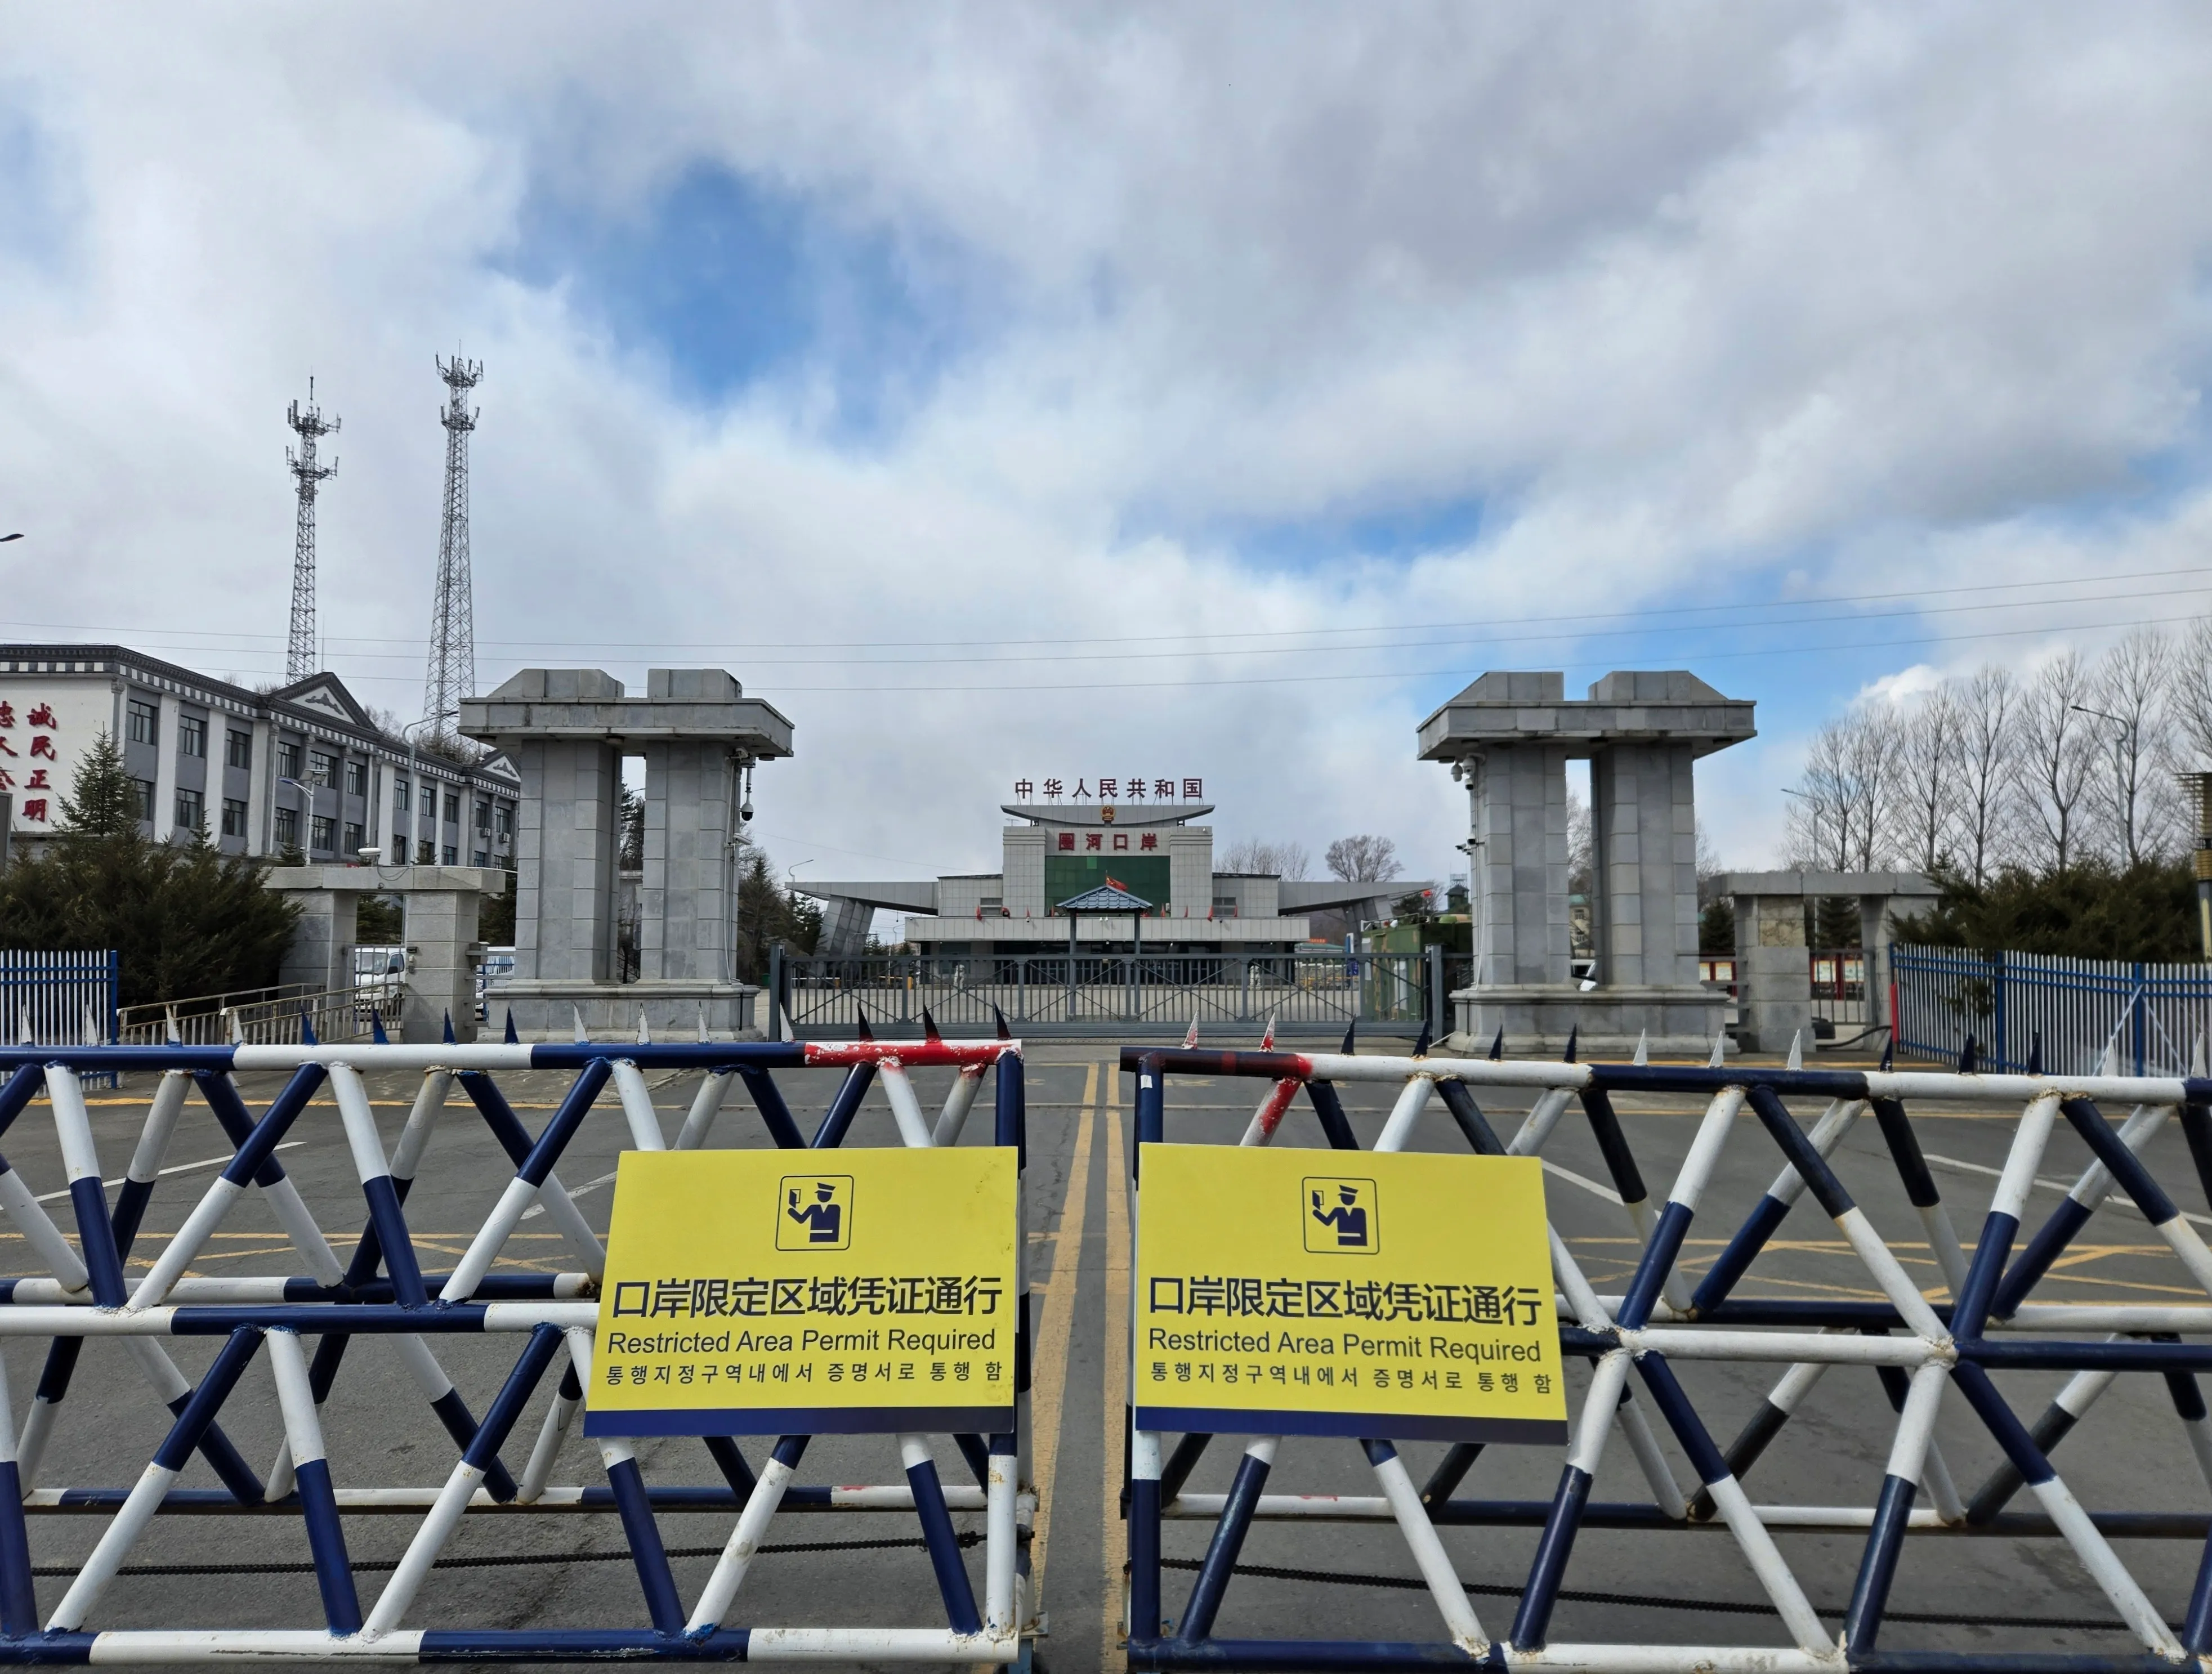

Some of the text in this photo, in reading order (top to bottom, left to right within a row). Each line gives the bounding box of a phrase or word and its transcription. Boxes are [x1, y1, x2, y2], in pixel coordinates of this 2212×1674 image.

[1015, 778, 1202, 799] 中华人民共和国
[1059, 833, 1158, 851] 圈河口岸
[613, 1275, 1002, 1318] 口岸限定区域凭证通行
[1151, 1275, 1541, 1326] 口岸限定区域凭证通行
[609, 1329, 994, 1355] Restricted Area Permit Required
[1150, 1328, 1540, 1364] Restricted Area Permit Required
[607, 1362, 1002, 1385] 통행지정구역내에서 증명서로 통행 함
[1152, 1362, 1550, 1393] 통행지정구역내에서 증명서로 통행 함
